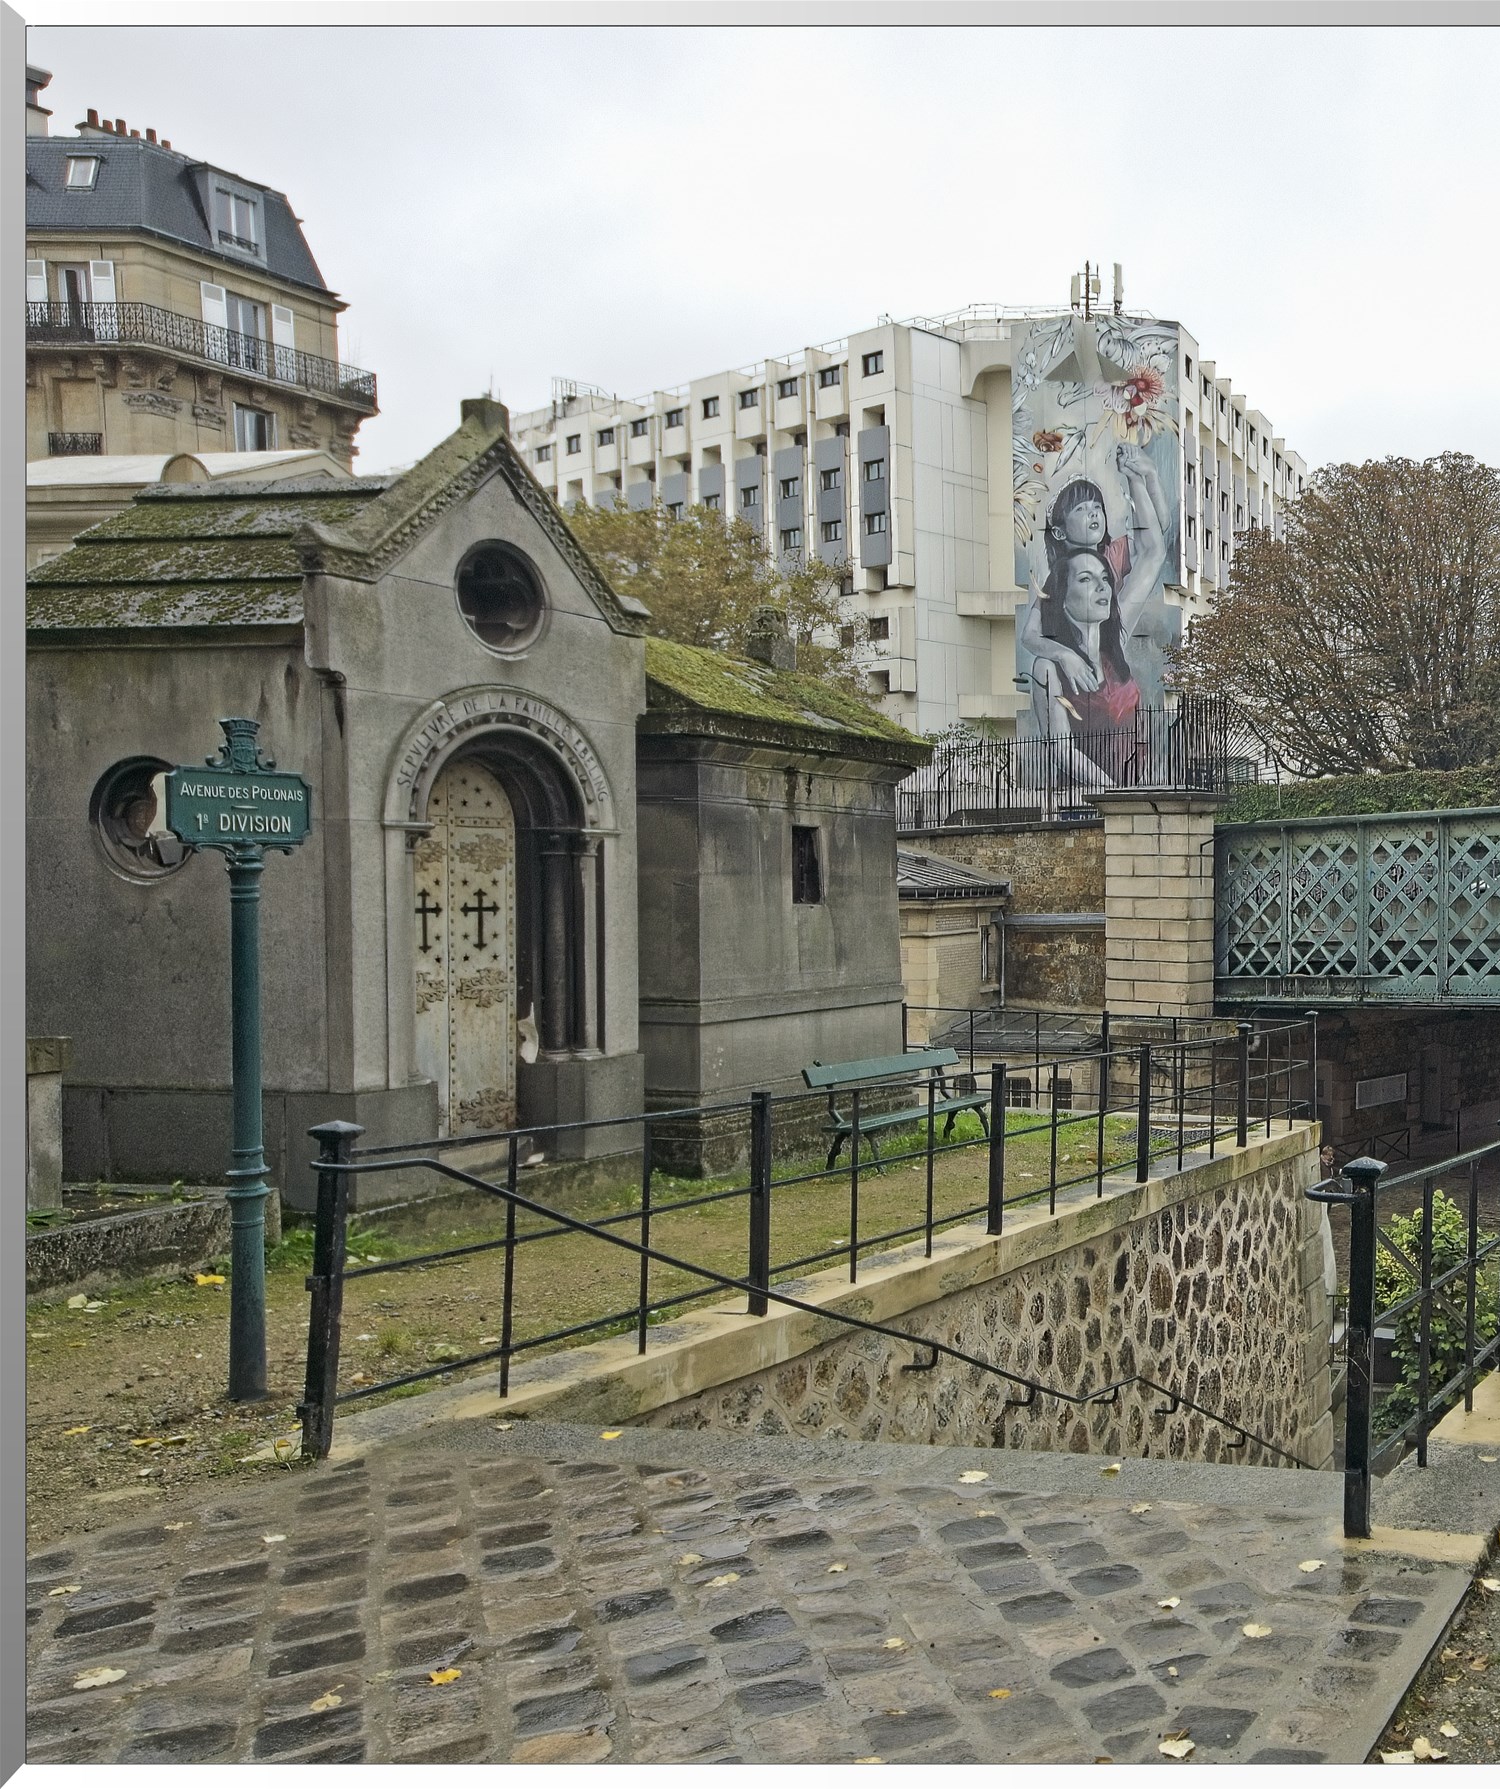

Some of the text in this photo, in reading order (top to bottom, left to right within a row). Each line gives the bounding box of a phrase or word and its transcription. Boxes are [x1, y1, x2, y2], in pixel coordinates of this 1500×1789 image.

[397, 694, 608, 802] SEPVLTVRE DE LA FAMILLE EBELING
[180, 782, 303, 802] AVENUE DES POLONAIS
[219, 813, 291, 833] DIVISION
